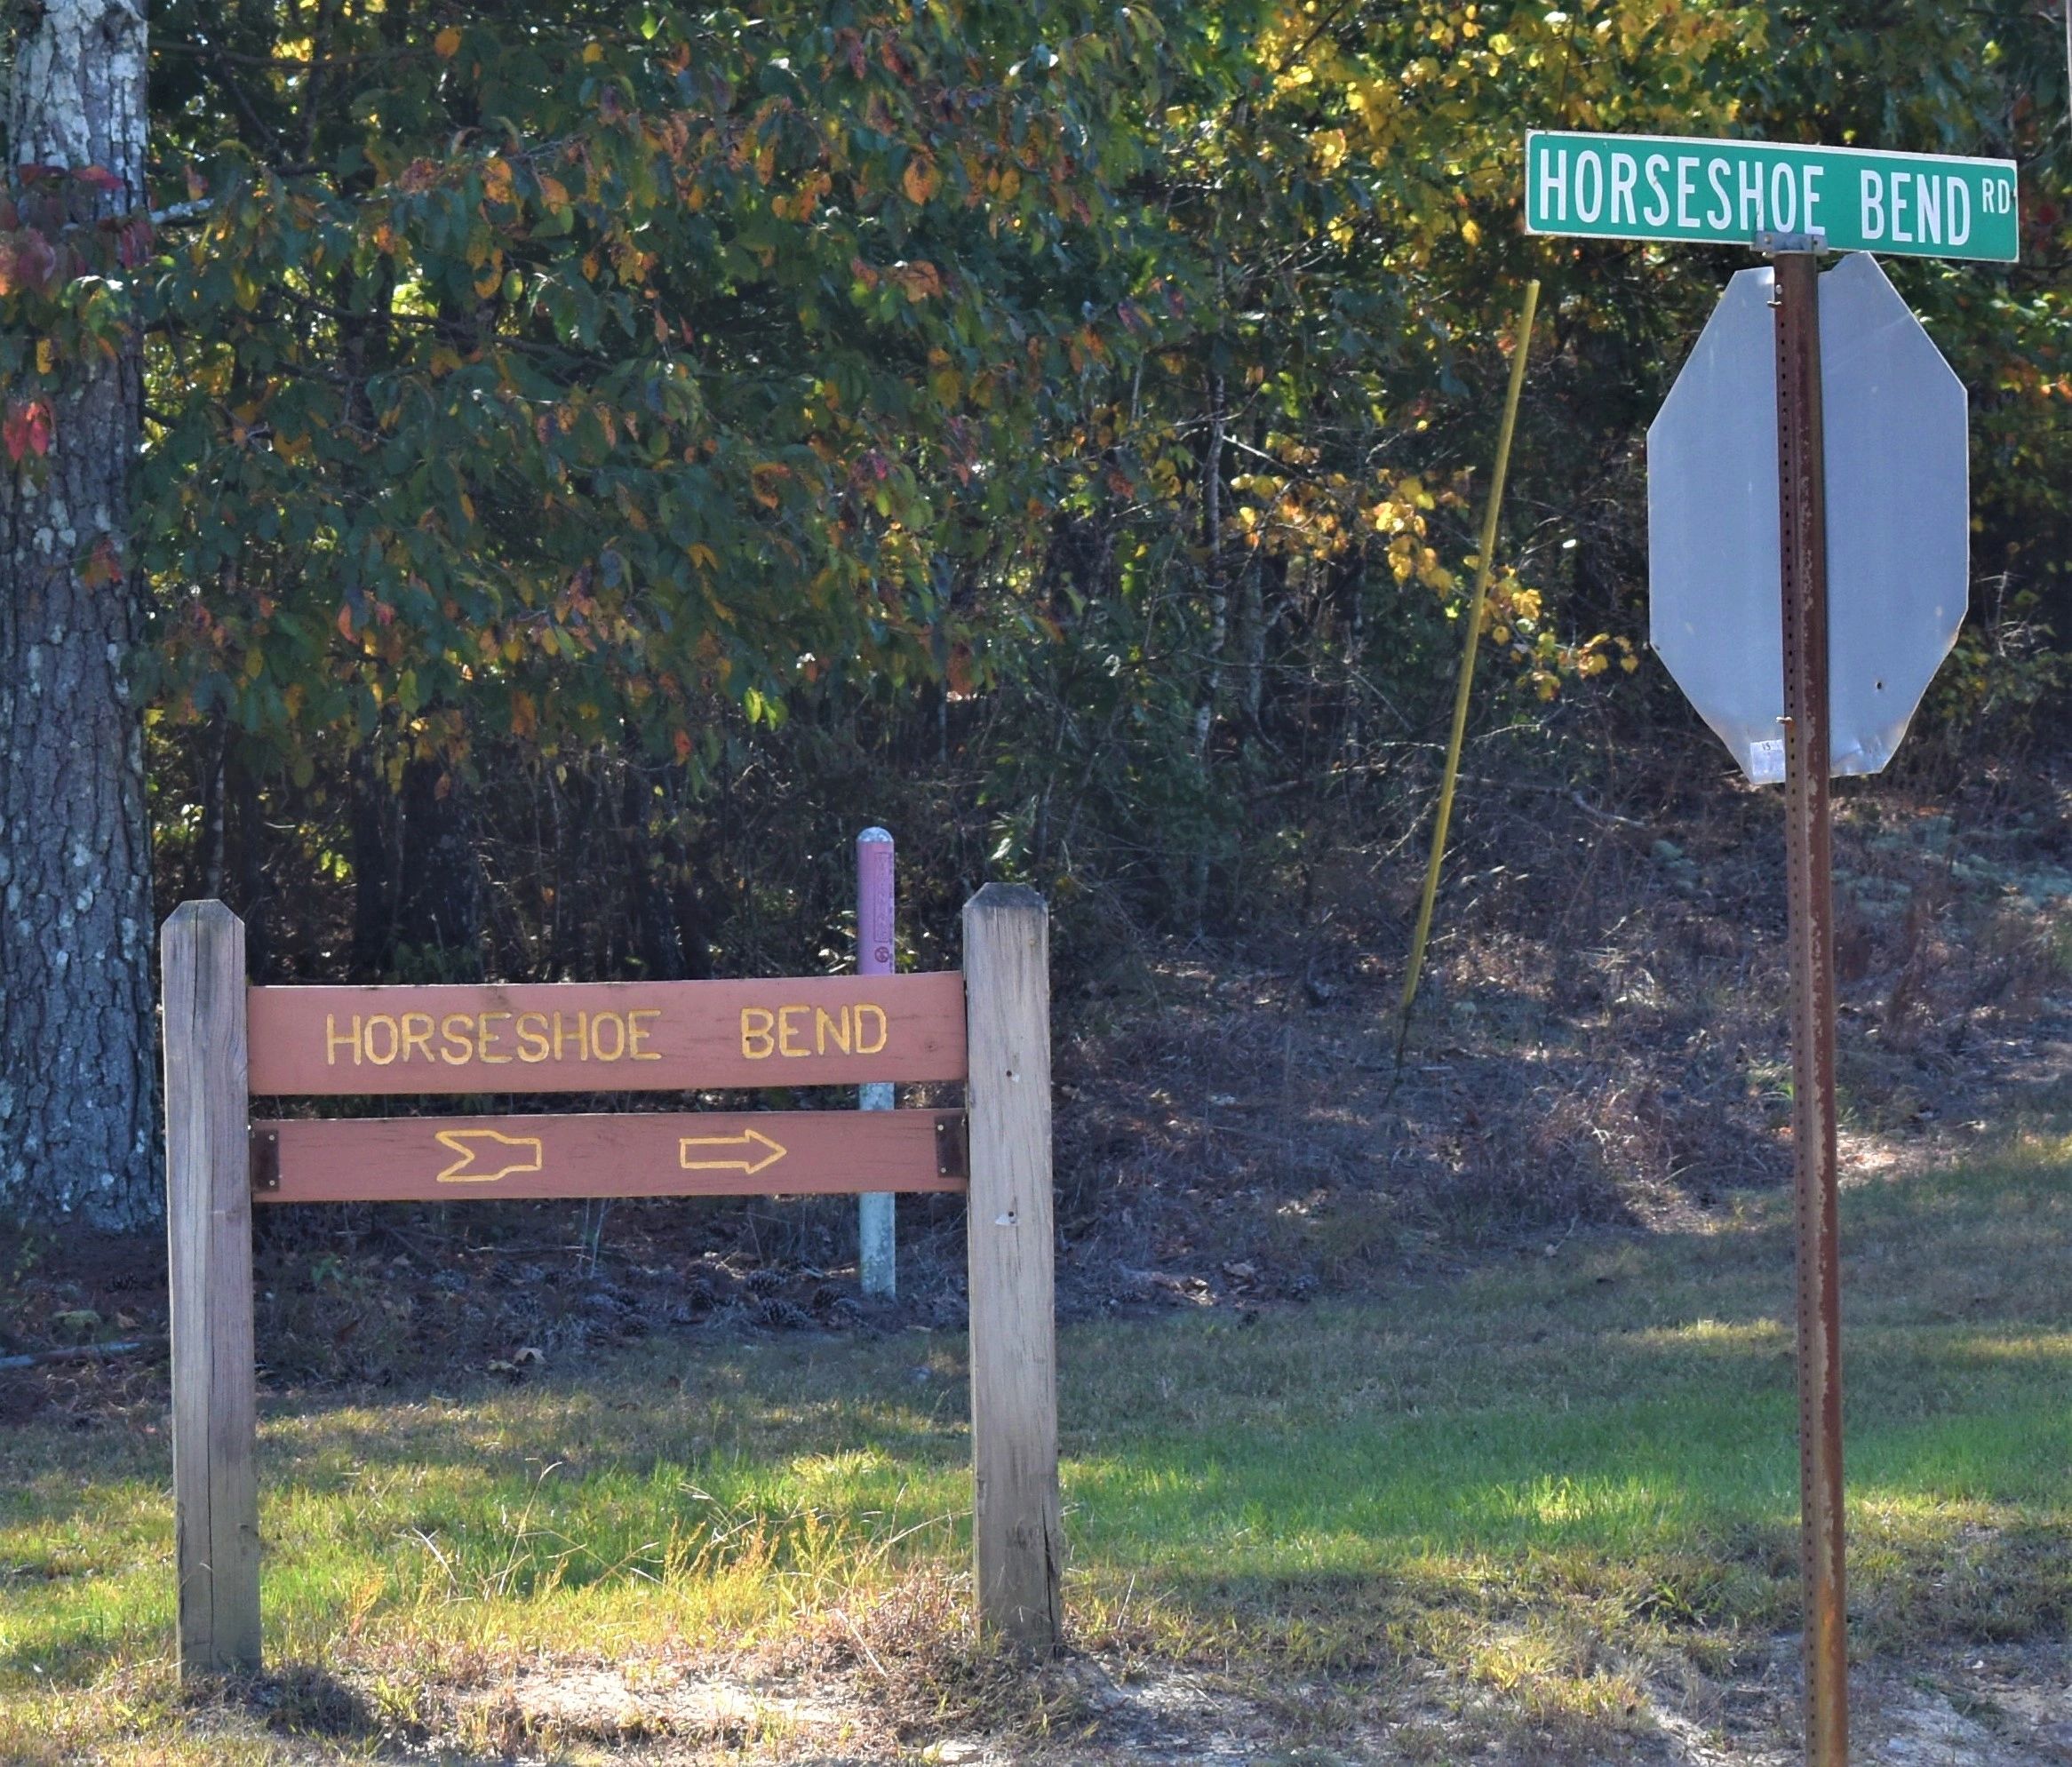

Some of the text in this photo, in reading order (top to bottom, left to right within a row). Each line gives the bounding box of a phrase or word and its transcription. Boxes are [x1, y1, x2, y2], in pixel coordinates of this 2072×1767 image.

[1539, 147, 2011, 246] HORSESHOE BEND RD
[325, 1003, 889, 1066] HORSESHOE BEND
